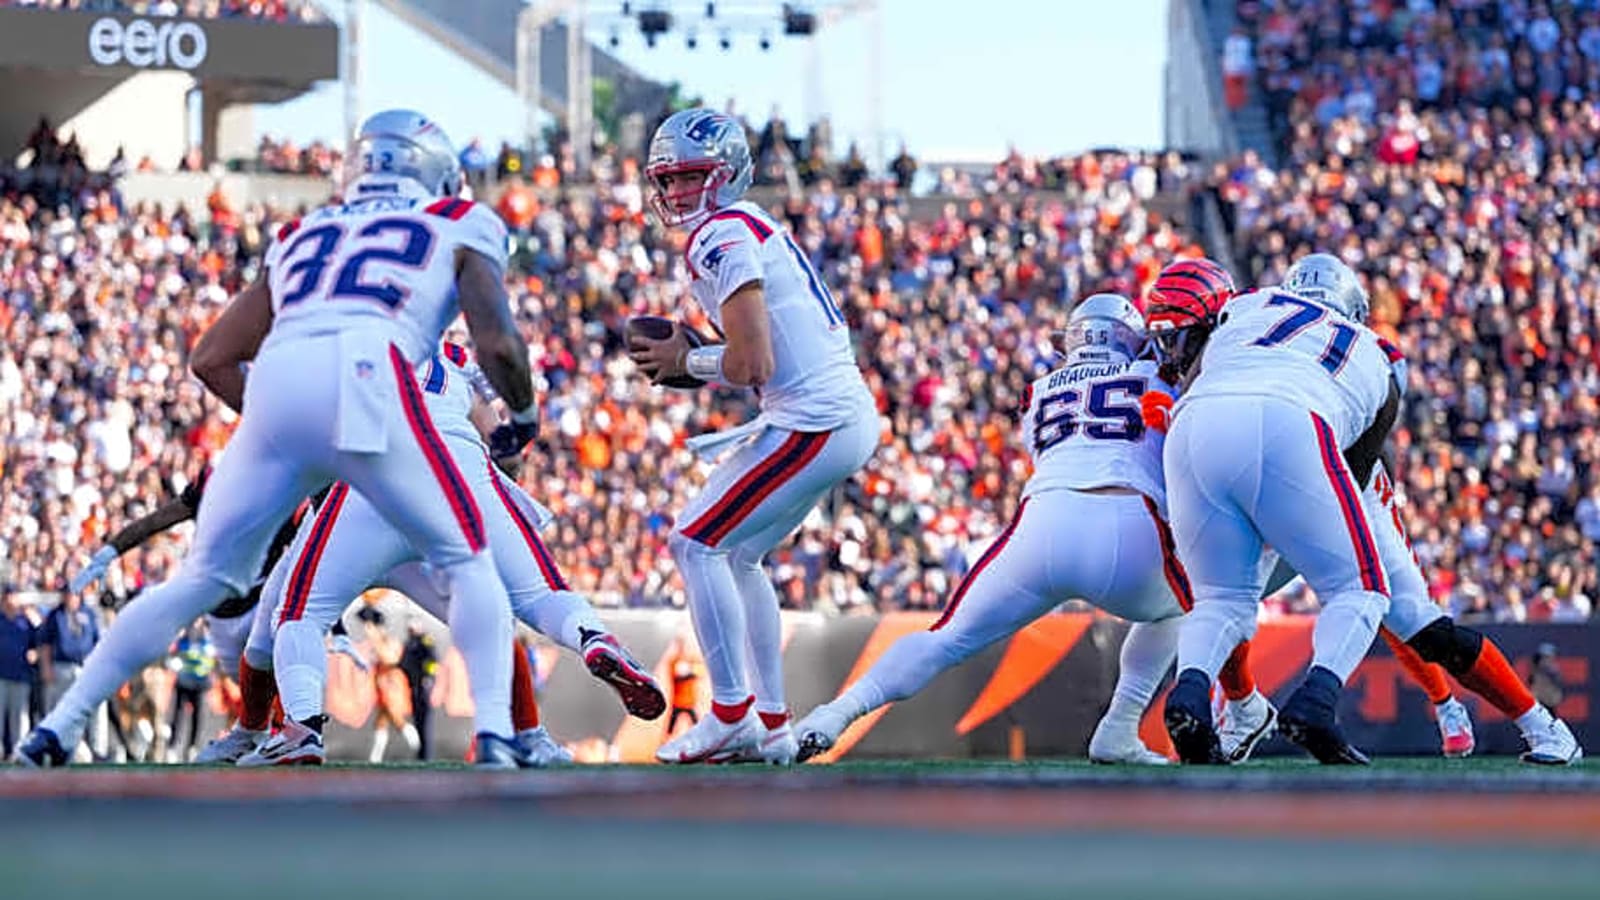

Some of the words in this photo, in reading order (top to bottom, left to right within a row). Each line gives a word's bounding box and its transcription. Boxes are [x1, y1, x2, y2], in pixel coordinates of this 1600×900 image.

[89, 17, 207, 69] eero
[279, 217, 437, 316] 32
[782, 233, 846, 330] 1
[1299, 270, 1319, 285] 71
[1084, 328, 1108, 345] 65
[1248, 292, 1357, 376] 71
[1034, 376, 1148, 455] 65
